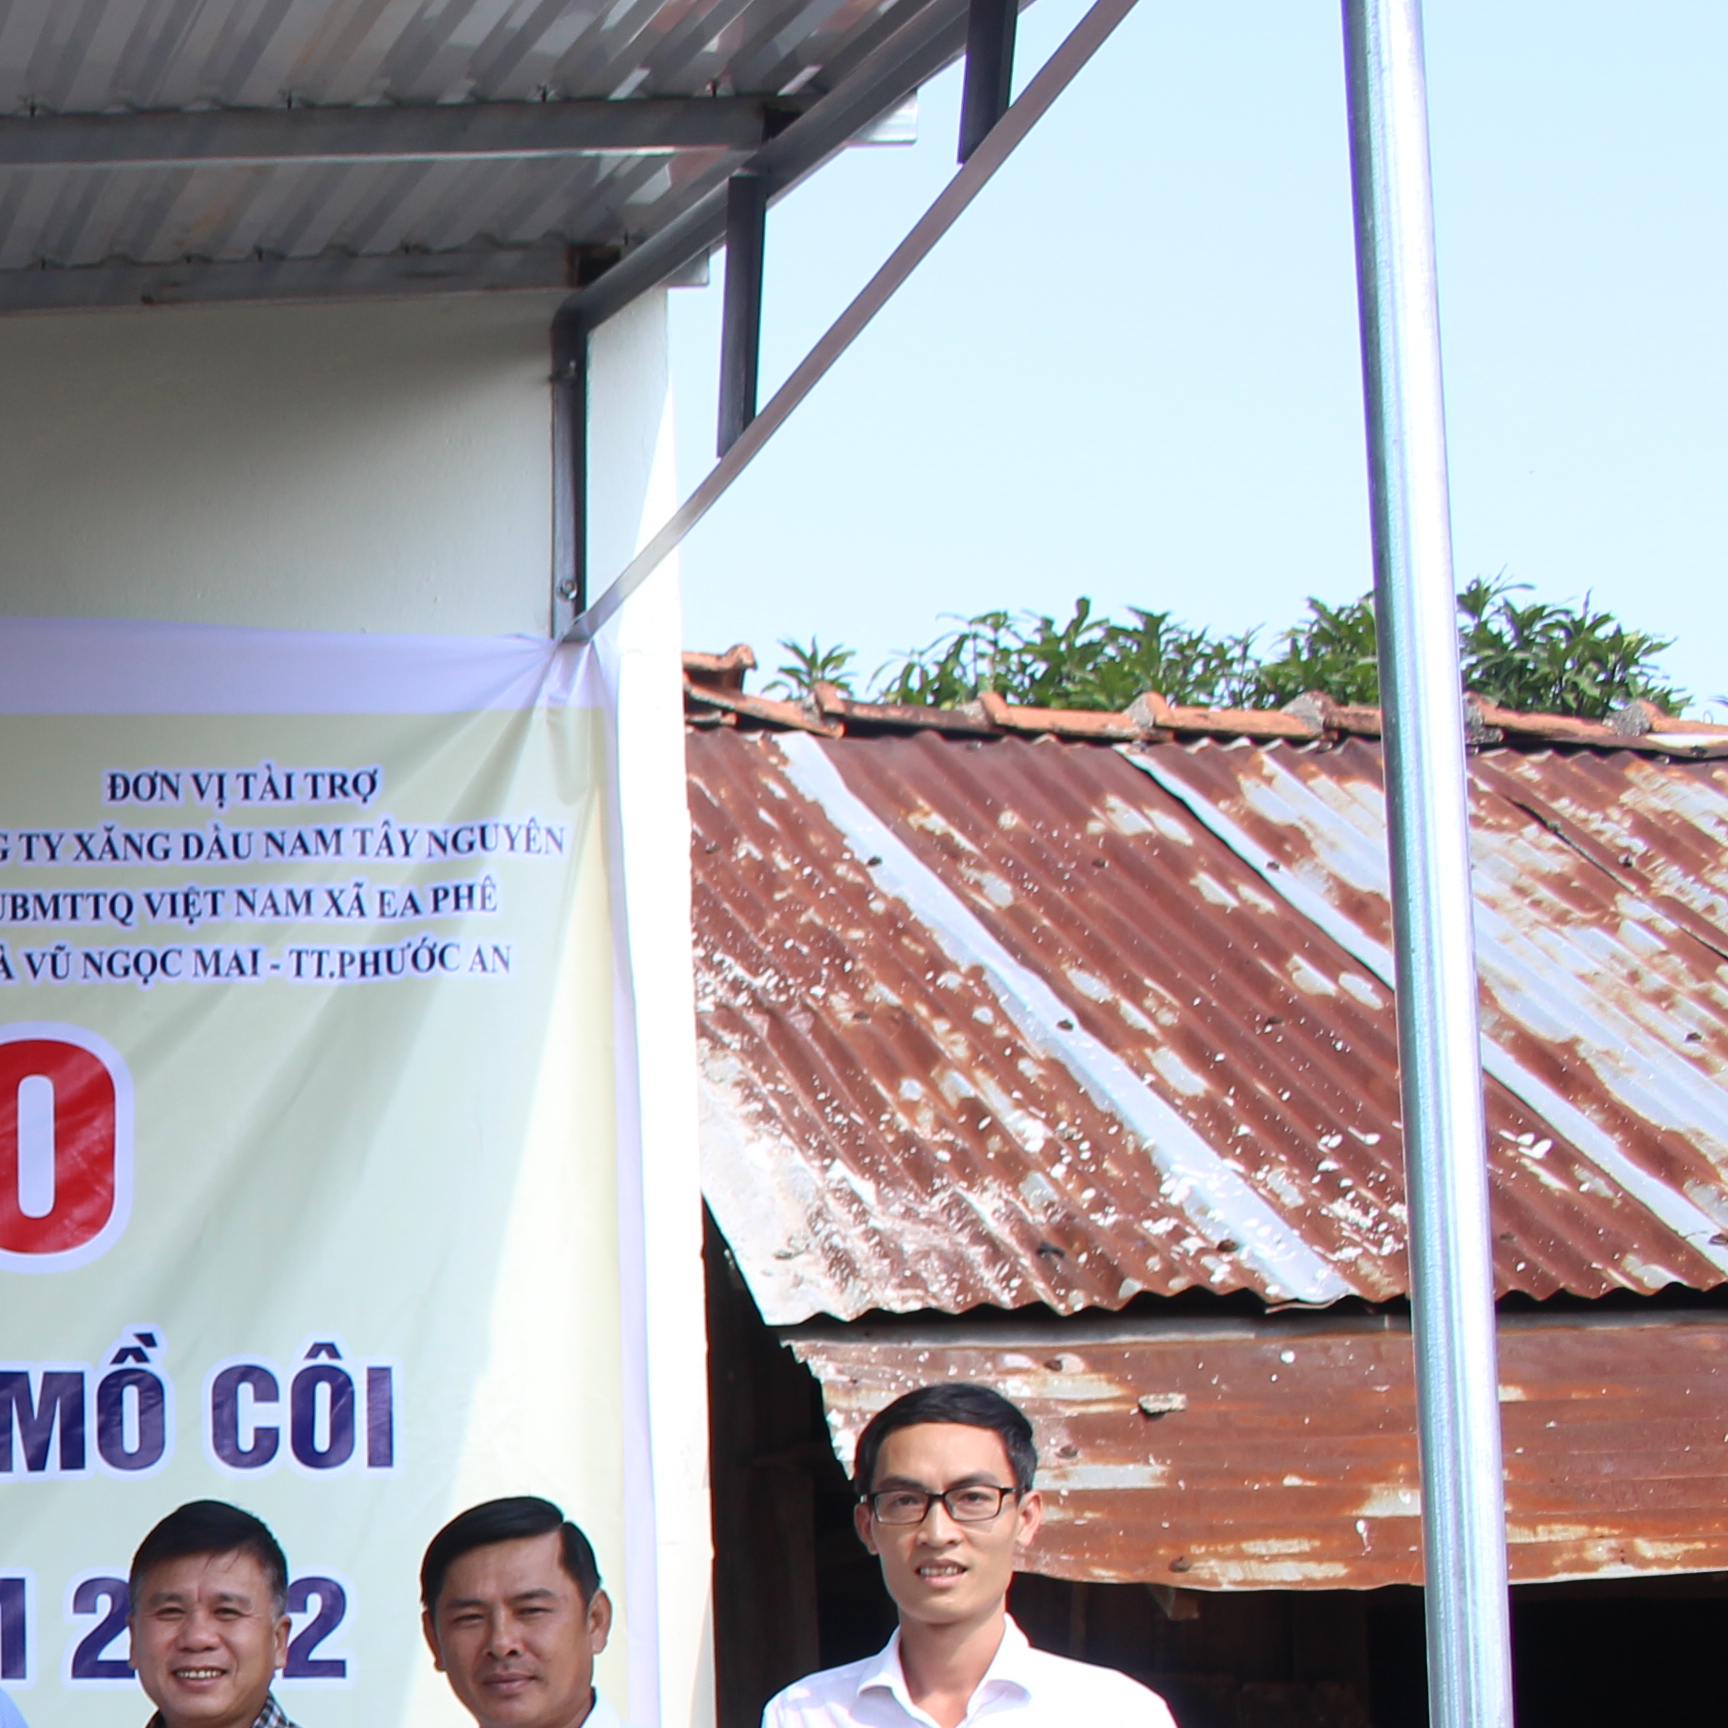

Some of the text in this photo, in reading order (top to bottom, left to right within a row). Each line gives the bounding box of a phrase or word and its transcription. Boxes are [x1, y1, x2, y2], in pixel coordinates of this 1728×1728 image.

[108, 764, 378, 809] ĐƠN VỊ TÀI TRỢ
[19, 833, 64, 862] TY
[73, 825, 171, 861] XĂNG
[181, 823, 253, 861] DẦU
[263, 828, 343, 858] NAM
[353, 819, 418, 858] TÂY
[425, 817, 565, 857] NGUYÊN
[144, 887, 225, 925] VIỆT
[235, 889, 312, 917] NAM
[323, 881, 367, 918] XÃ
[377, 890, 422, 918] EA
[431, 874, 497, 914] PHÊ
[24, 944, 71, 981] VŨ
[82, 949, 182, 985] NGỌC
[193, 948, 260, 978] MAI
[290, 937, 461, 980] TT.PHƯỚC
[469, 945, 511, 973] AN
[210, 1342, 394, 1470] CÔI
